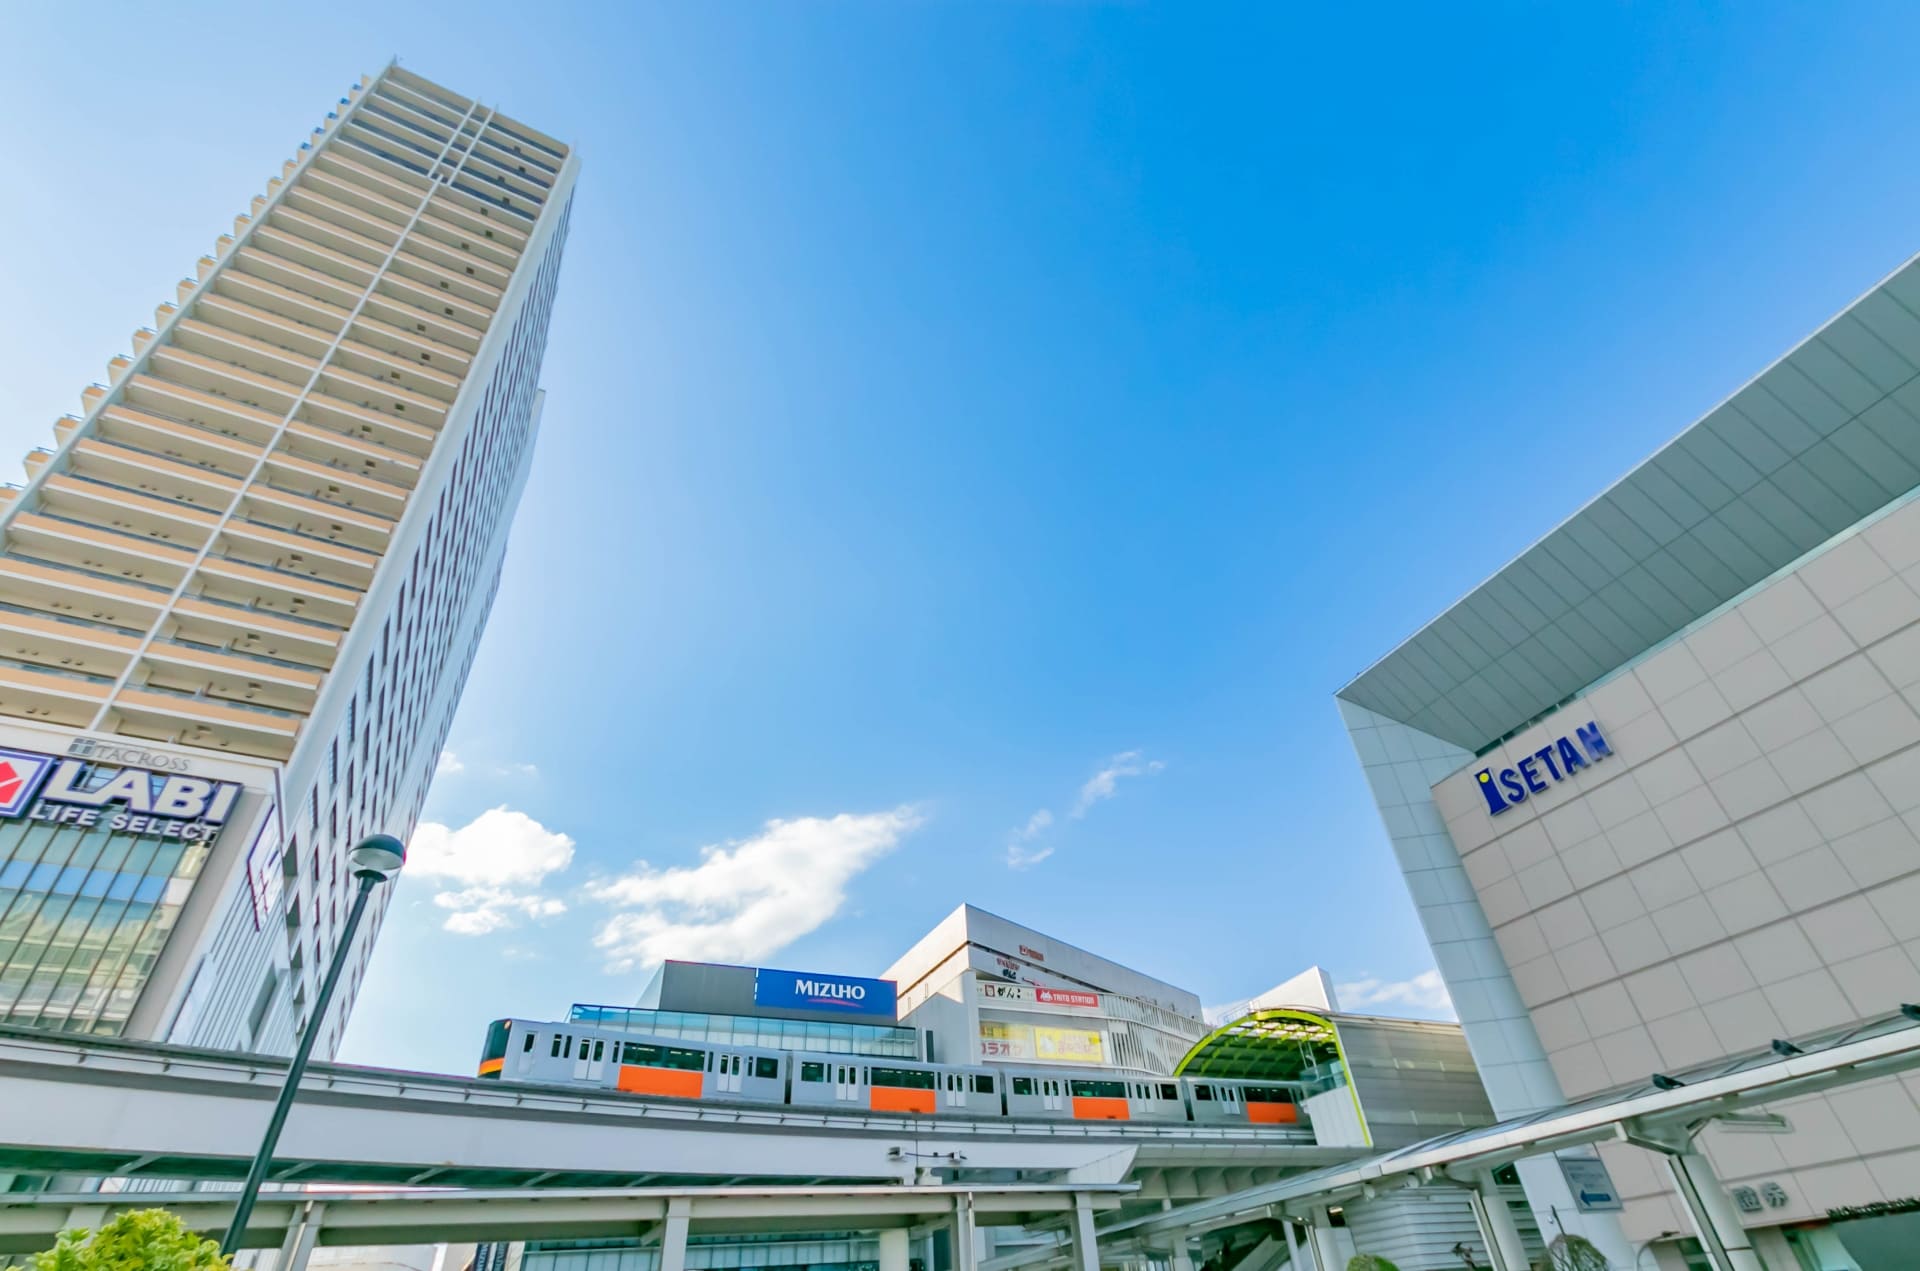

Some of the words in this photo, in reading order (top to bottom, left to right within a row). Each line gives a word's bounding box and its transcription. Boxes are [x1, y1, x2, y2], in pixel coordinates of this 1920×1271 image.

[41, 760, 242, 823] LABI
[29, 804, 99, 826] LIFE
[110, 813, 220, 841] SELECT
[795, 979, 866, 1000] MIZUHO
[997, 986, 1021, 1000] がんこ
[1053, 993, 1070, 1002] TAITO
[1071, 995, 1095, 1004] STATION
